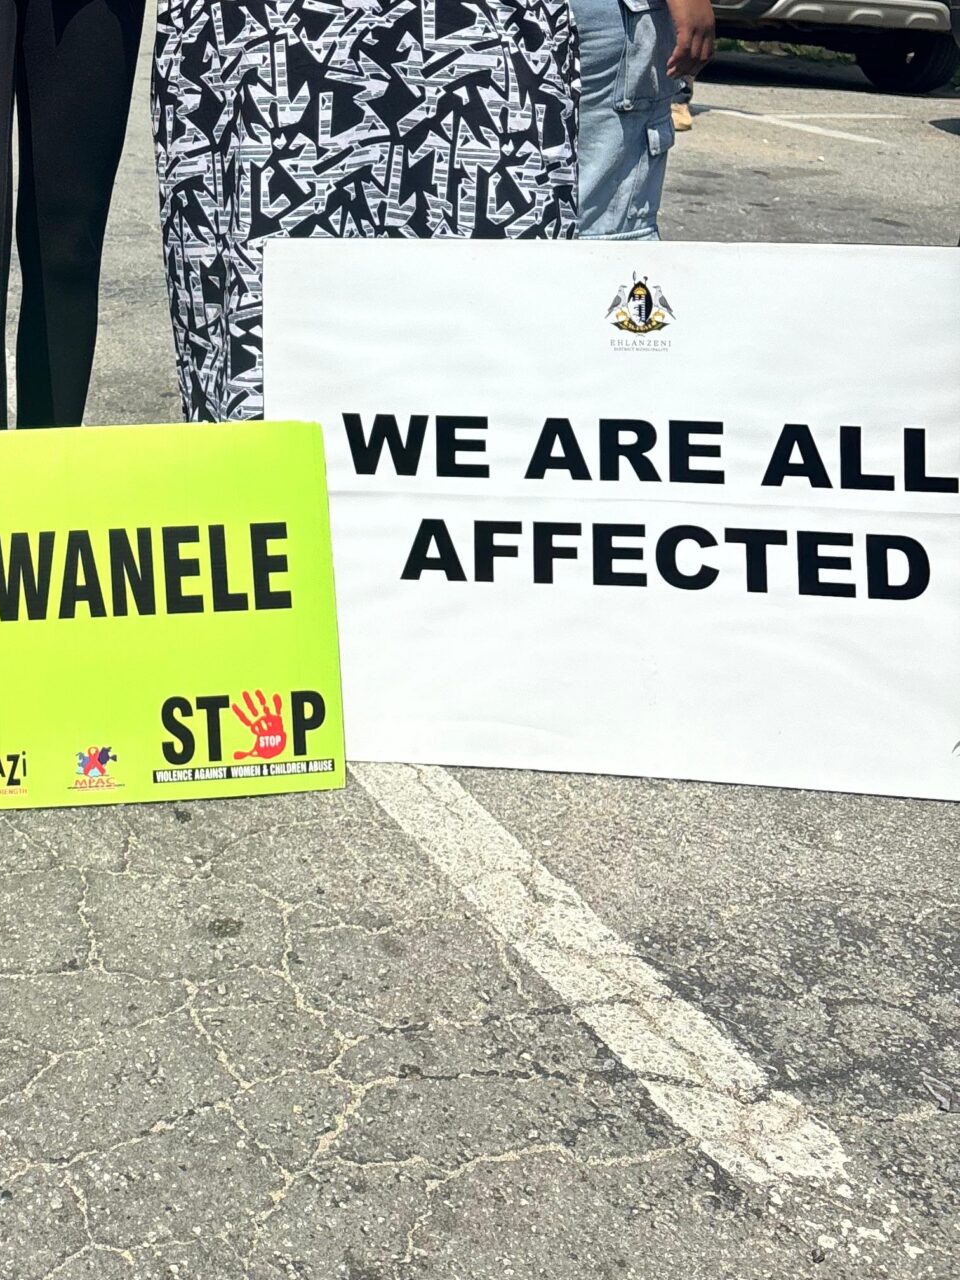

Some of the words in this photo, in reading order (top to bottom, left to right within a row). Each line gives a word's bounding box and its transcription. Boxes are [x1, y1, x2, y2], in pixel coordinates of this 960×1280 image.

[342, 412, 491, 479] WE
[524, 418, 726, 485] ARE
[760, 423, 960, 494] ALL
[400, 517, 932, 601] AFFECTED
[258, 735, 282, 748] STOP
[155, 769, 193, 783] VIOLENCE
[194, 767, 228, 781] AGAINST
[230, 765, 261, 778] WOMEN
[262, 764, 269, 776] &
[269, 761, 307, 775] CHILDREN
[308, 759, 333, 772] ABUSE
